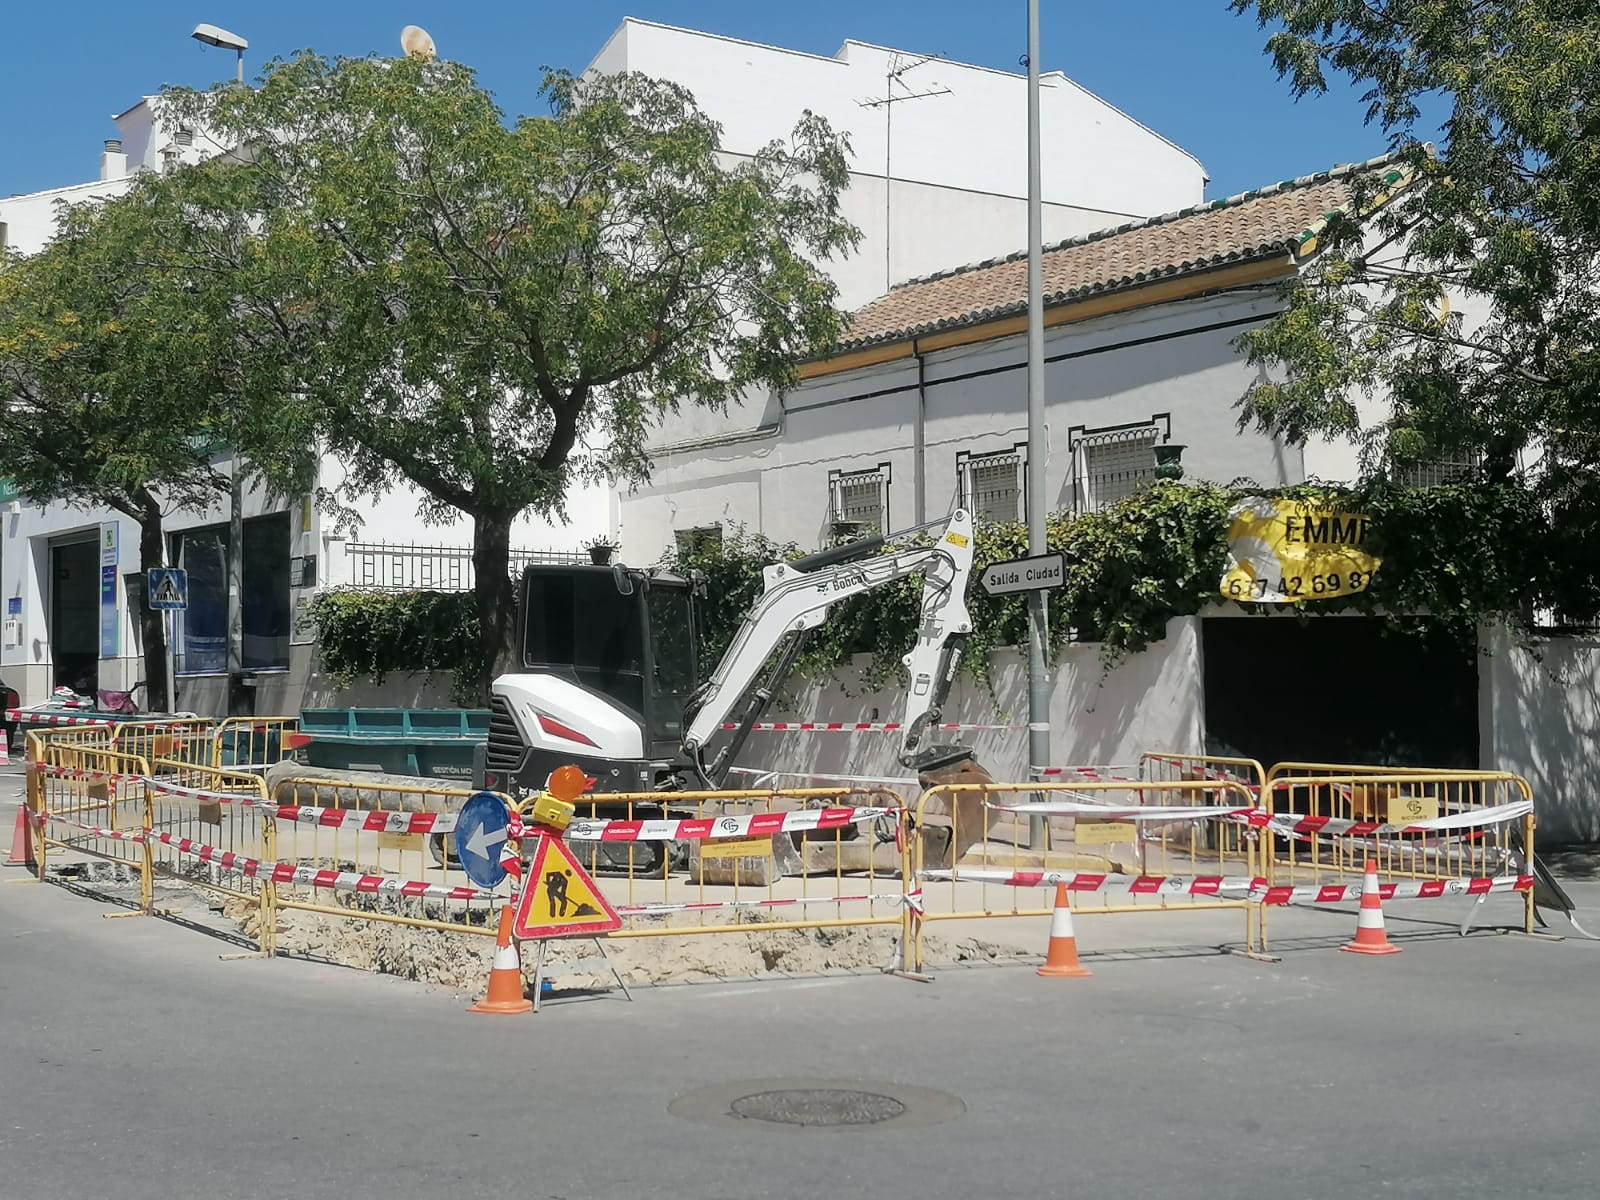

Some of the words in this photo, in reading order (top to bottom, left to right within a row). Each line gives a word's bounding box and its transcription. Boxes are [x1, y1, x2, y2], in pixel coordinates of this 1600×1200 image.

[990, 571, 1019, 586] Salida
[1026, 565, 1059, 581] Ciudad
[1312, 573, 1341, 593] 69
